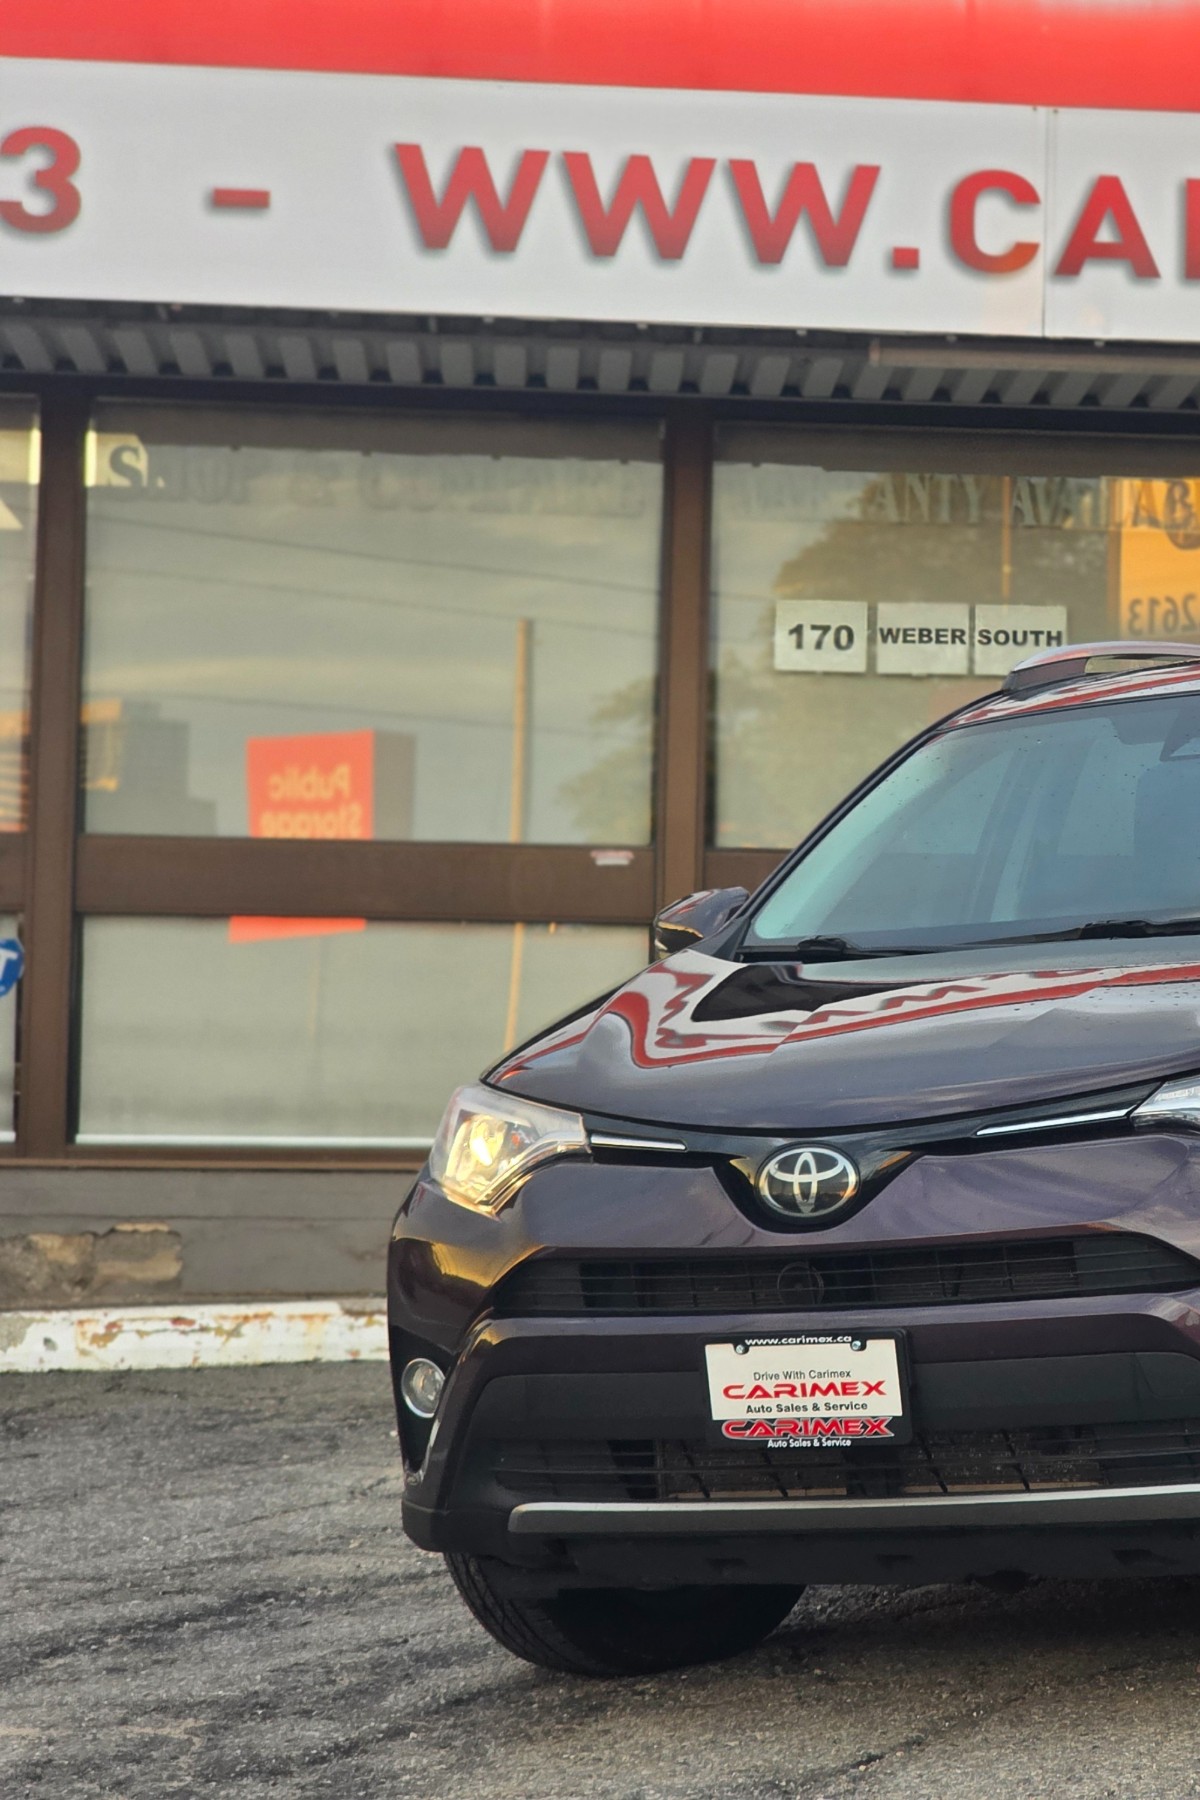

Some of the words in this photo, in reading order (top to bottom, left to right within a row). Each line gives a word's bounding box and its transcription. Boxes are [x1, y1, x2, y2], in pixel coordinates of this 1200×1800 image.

[0, 126, 82, 233] 3
[787, 623, 855, 651] 170
[879, 626, 967, 646] WEBER
[977, 627, 1063, 648] SOUTH
[744, 1334, 853, 1346] www.carimex.ca
[753, 1370, 780, 1382] Drive
[782, 1369, 805, 1380] With
[808, 1369, 852, 1380] Carimex
[722, 1380, 887, 1400] CARIMEX
[746, 1403, 773, 1414] Auto
[776, 1402, 808, 1413] Sales
[811, 1402, 821, 1412] &
[824, 1400, 868, 1411] Service
[722, 1417, 894, 1438] CARIMEX
[767, 1438, 788, 1449] Auto
[789, 1438, 812, 1448] Sales
[813, 1438, 821, 1448] &
[821, 1437, 852, 1447] Service
